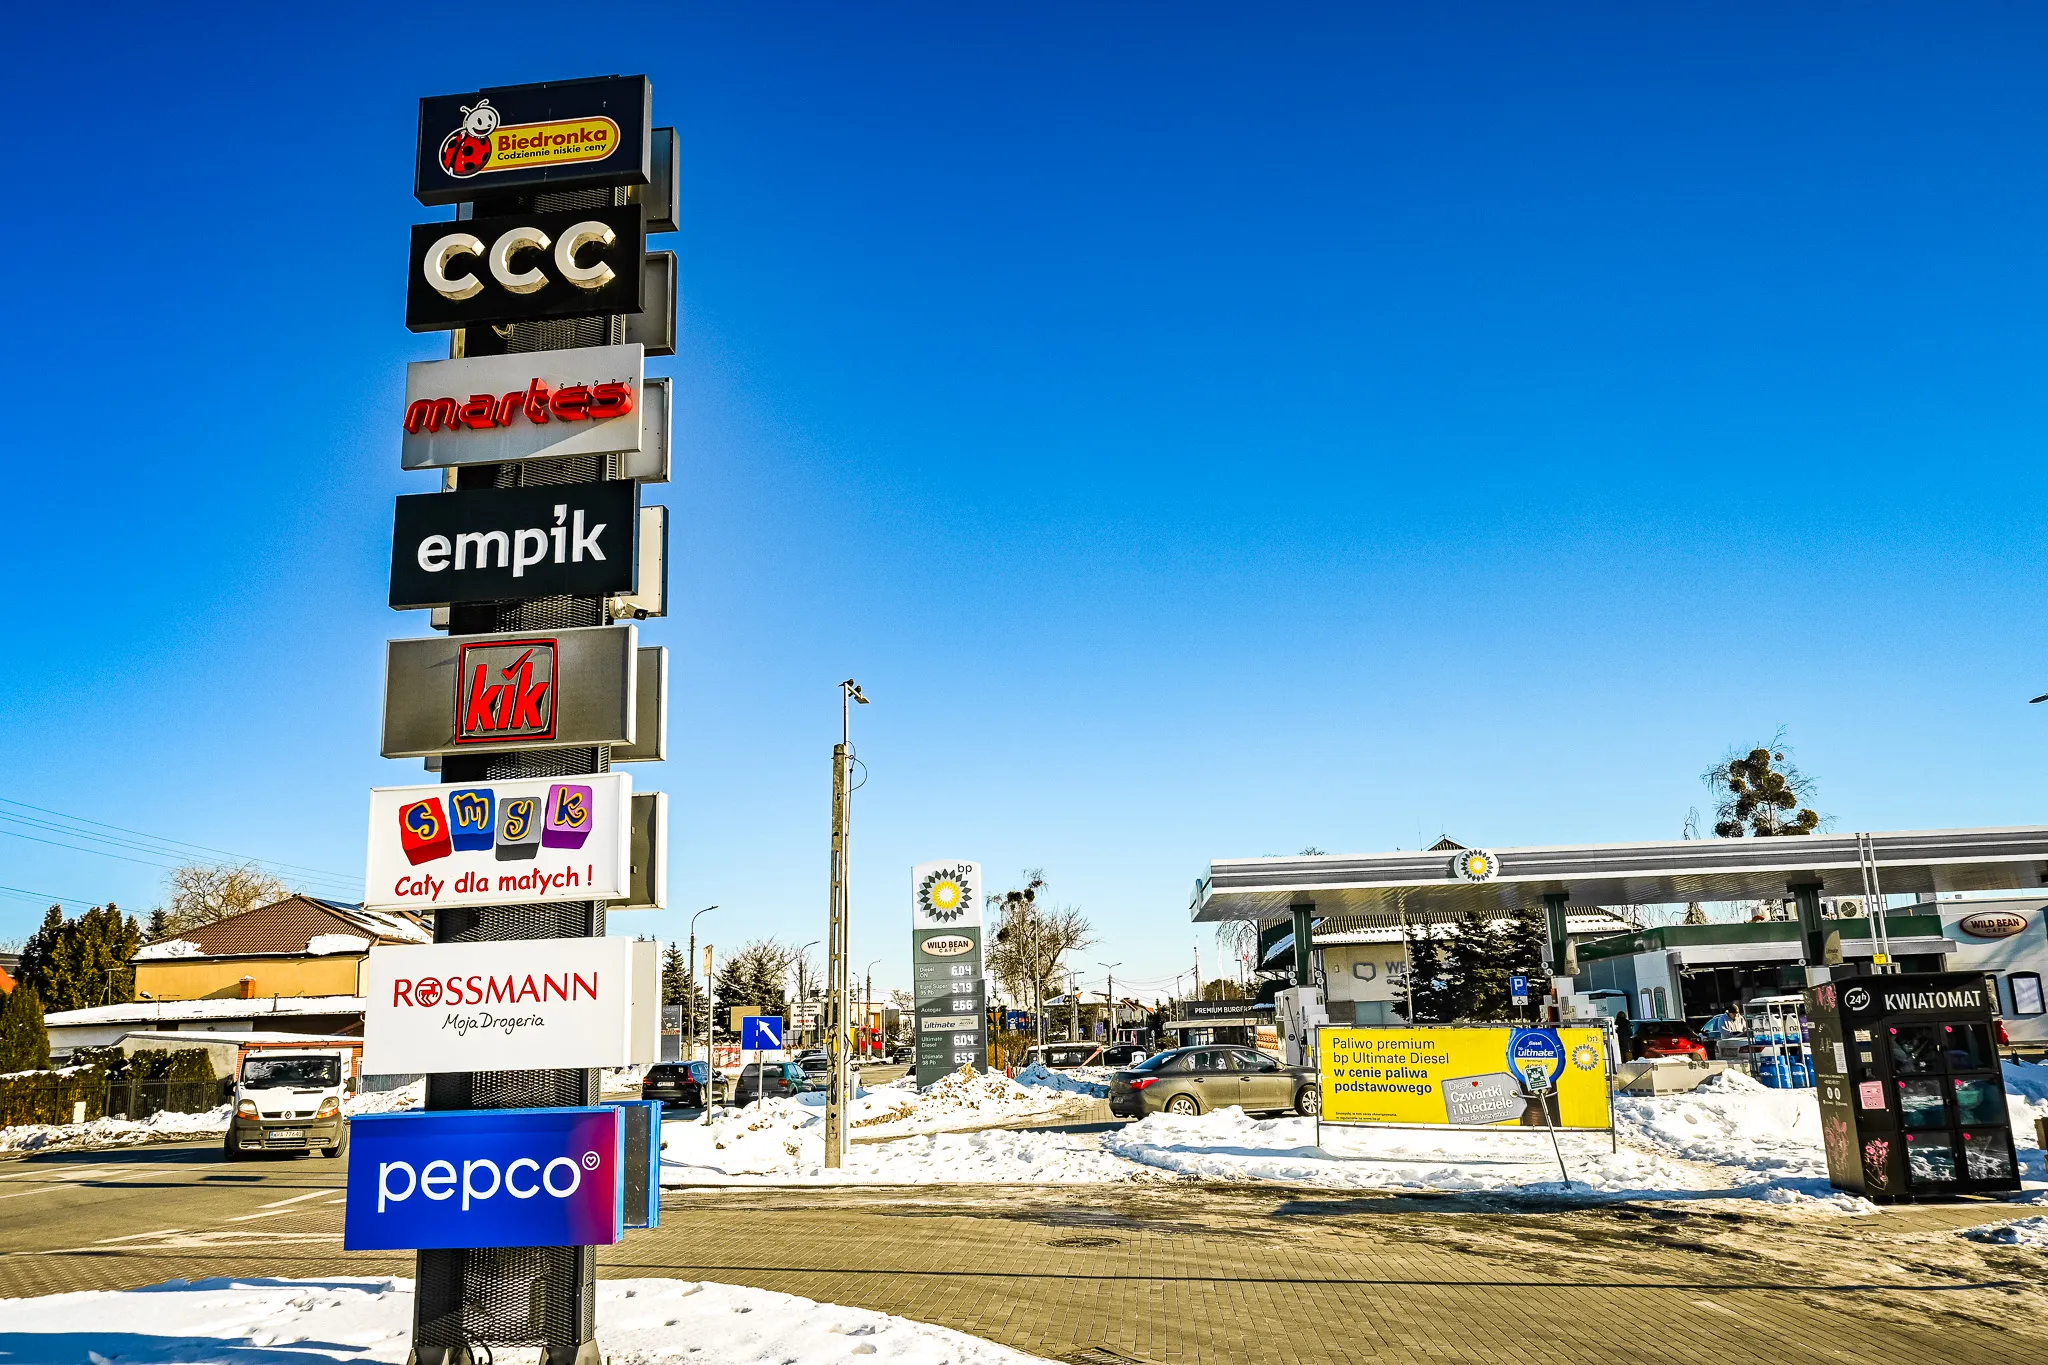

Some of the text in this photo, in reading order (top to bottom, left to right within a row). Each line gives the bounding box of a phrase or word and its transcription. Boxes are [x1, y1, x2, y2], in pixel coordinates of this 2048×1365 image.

[498, 128, 607, 151] Biedronka
[498, 144, 607, 160] Codziennie niskie ceny
[424, 221, 616, 300] CCC
[403, 377, 633, 434] martes
[417, 504, 607, 578] empik
[957, 863, 972, 875] bp
[394, 873, 444, 901] Cały
[454, 871, 489, 894] dla
[498, 865, 579, 896] małych
[1971, 918, 2020, 929] WILD BEAN
[927, 940, 969, 949] WILD BEAN
[393, 971, 598, 1008] ROSSMANN
[1849, 993, 1867, 1005] 24h
[1884, 990, 1981, 1011] KWIATOMAT
[1194, 1006, 1223, 1014] PREMIUM
[442, 1011, 545, 1037] Moja Drogeria
[924, 1021, 956, 1029] ultimate
[1332, 1037, 1435, 1051] Paliwo premium
[1333, 1052, 1449, 1065] bp Ultimate Diesel
[1518, 1048, 1554, 1057] ultimate
[1334, 1066, 1428, 1080] w cenie paliwa
[1334, 1080, 1432, 1096] podstawowego
[1450, 1085, 1503, 1103] Czwartki
[1452, 1097, 1513, 1115] i Niedziele
[377, 1156, 581, 1213] pepco
